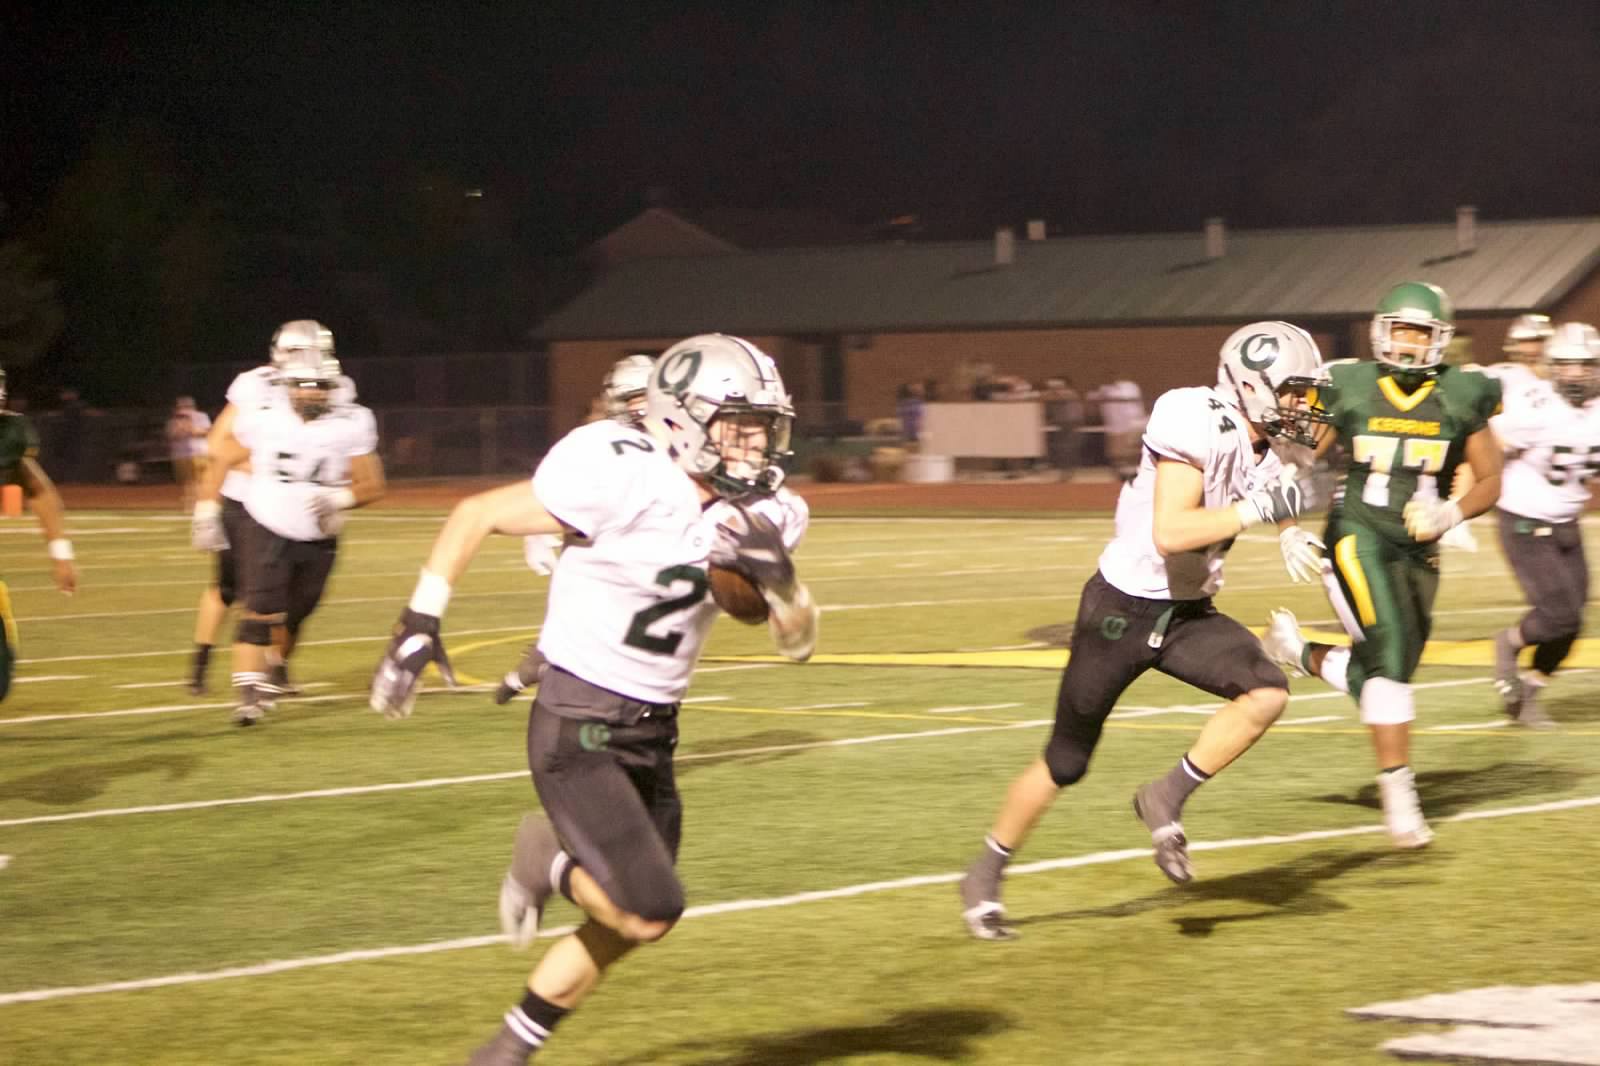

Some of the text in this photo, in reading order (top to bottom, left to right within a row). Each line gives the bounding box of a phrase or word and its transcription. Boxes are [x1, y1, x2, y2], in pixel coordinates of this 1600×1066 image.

[1208, 397, 1237, 434] 44
[611, 438, 655, 456] 2
[1352, 434, 1451, 507] 77
[623, 564, 709, 656] 2
